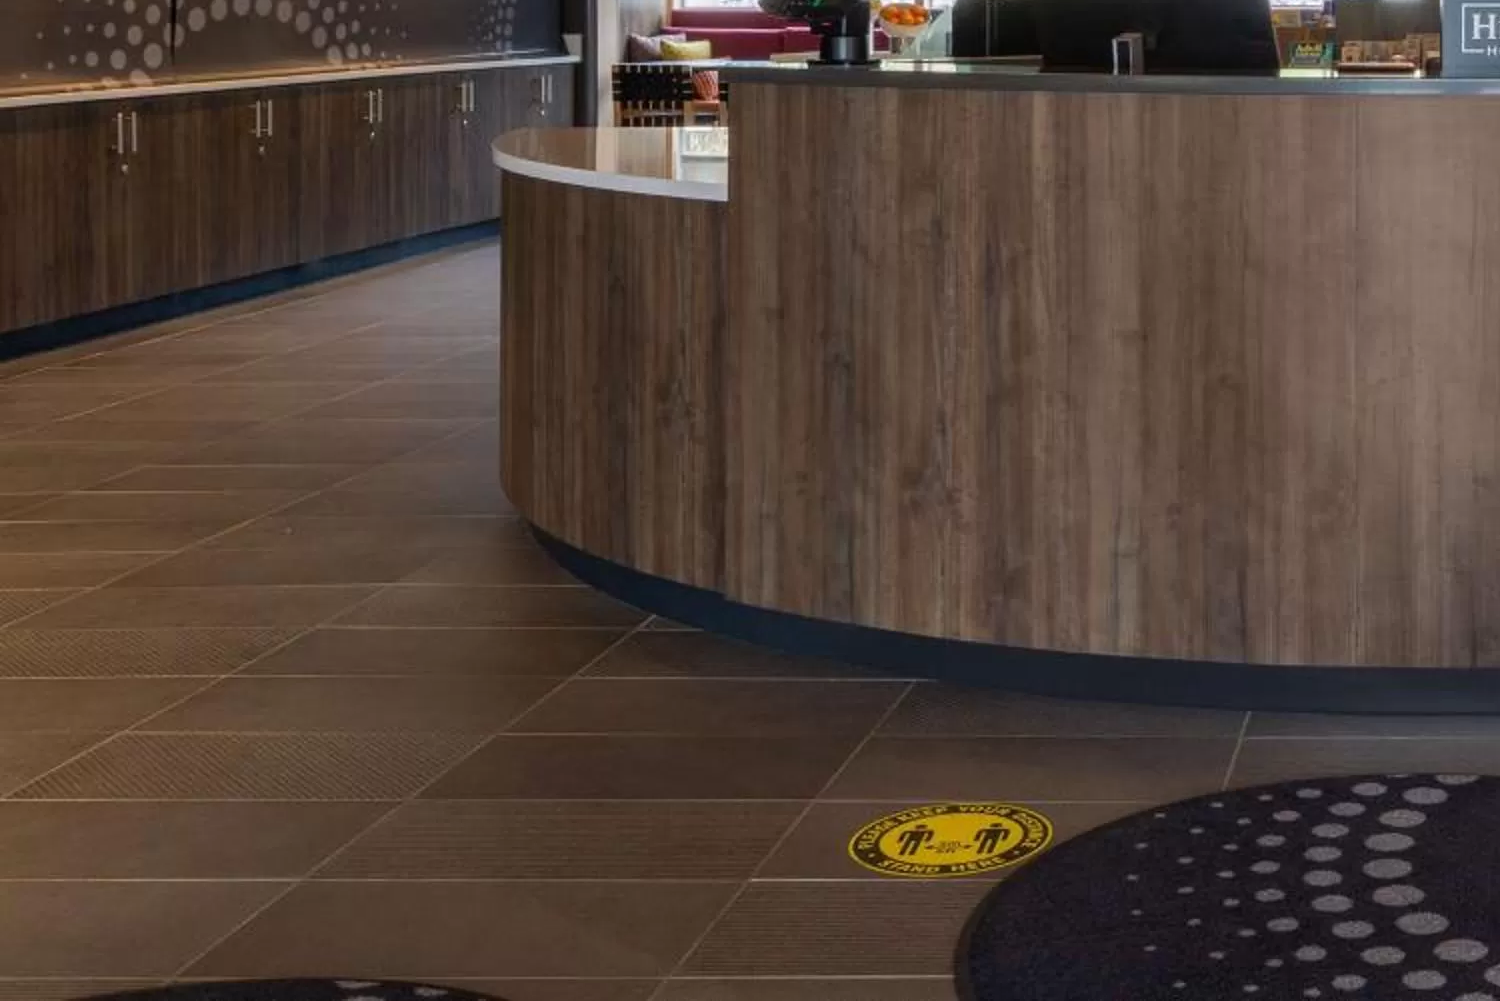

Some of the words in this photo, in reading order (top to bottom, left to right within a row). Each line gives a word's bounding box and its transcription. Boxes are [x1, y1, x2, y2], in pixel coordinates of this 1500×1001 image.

[896, 805, 948, 822] KEEP
[959, 804, 1012, 815] YOUR
[876, 859, 941, 874] STAND
[950, 857, 1006, 873] HERE
